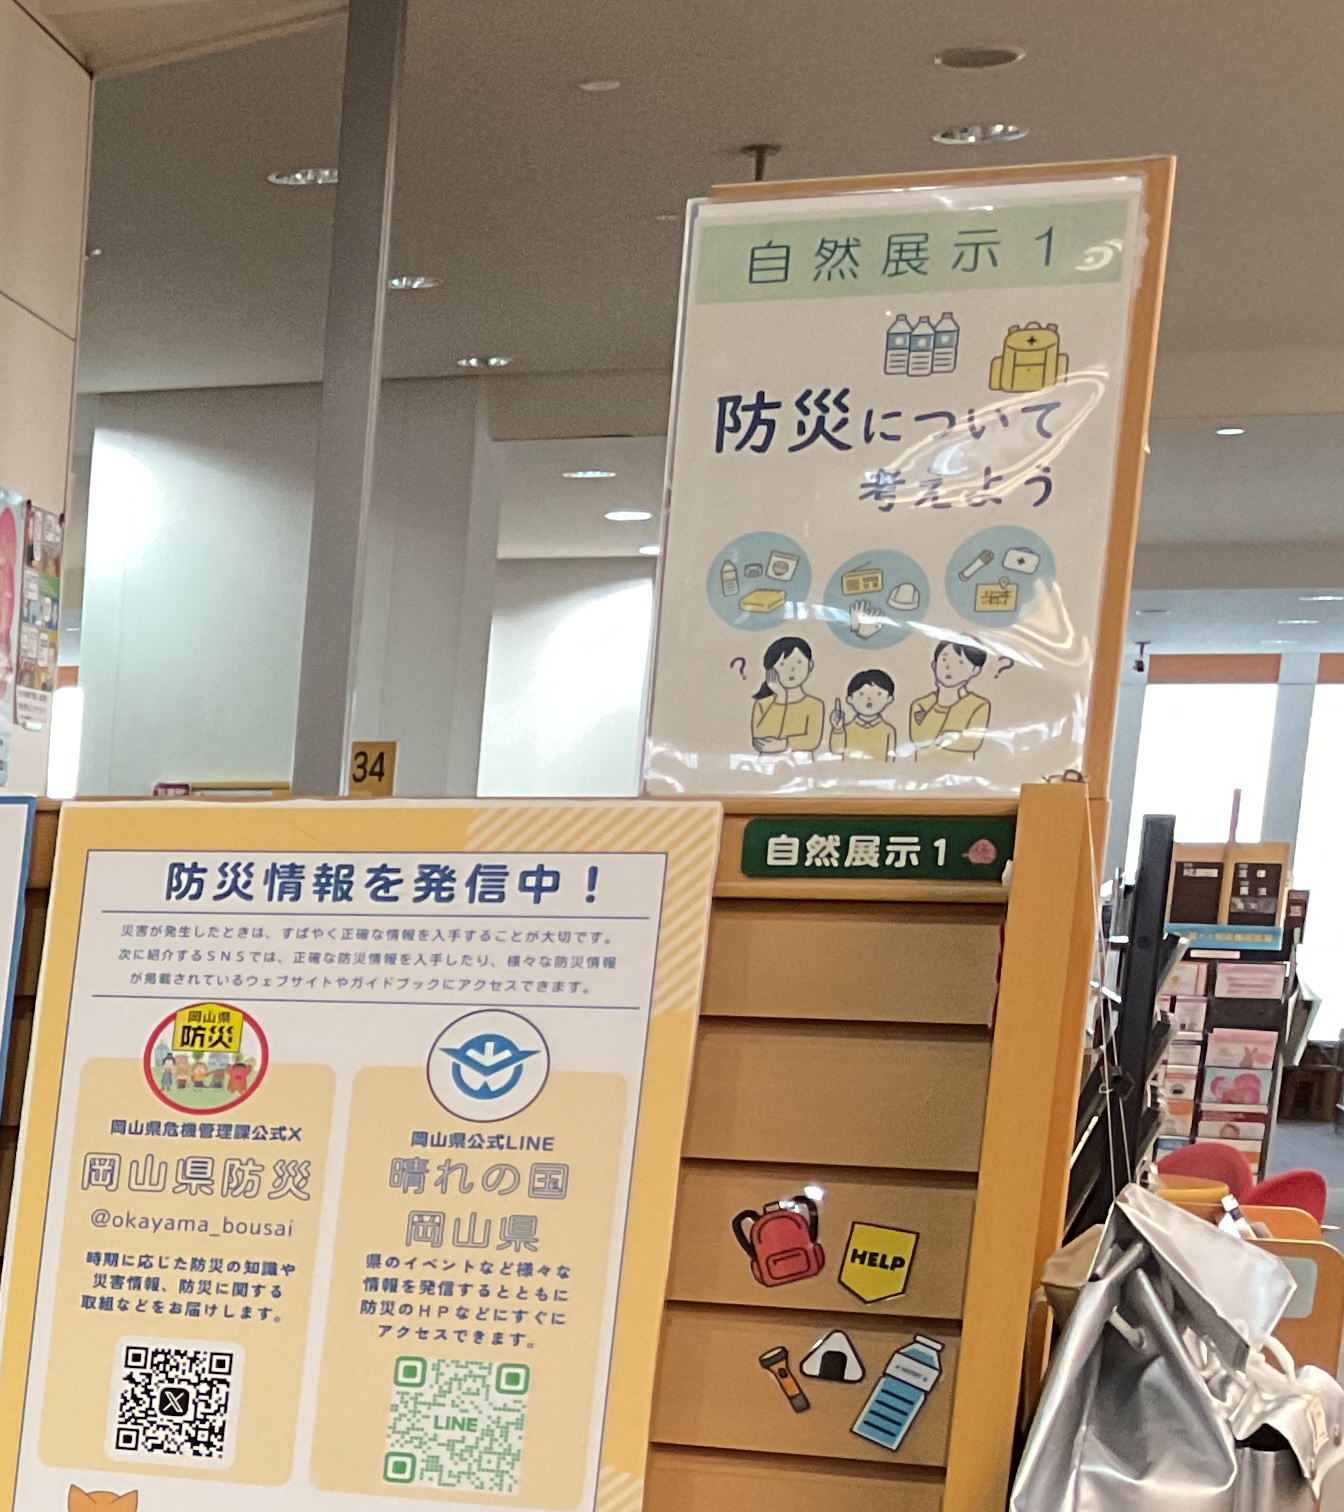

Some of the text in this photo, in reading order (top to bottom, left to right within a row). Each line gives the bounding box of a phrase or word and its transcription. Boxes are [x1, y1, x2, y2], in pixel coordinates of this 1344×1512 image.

[714, 386, 1063, 454] 防災について
[858, 465, 1054, 512] 考えよう
[351, 751, 386, 783] 34
[165, 860, 602, 905] 防災情報を発信中！
[120, 923, 612, 946] 災害が発生したときは、すばやく正確な情報を入手することが大切です。
[187, 1010, 231, 1024] 岡山県
[180, 1024, 234, 1050] 防災
[109, 1119, 303, 1143] 岡山県危機管理課公式X
[411, 1130, 555, 1153] 岡山県公式LINE
[80, 1151, 312, 1203] 岡山県防災
[388, 1157, 571, 1201] 晴れの国
[89, 1206, 295, 1239] @okayama_bousai
[404, 1210, 541, 1252] 岡山県
[85, 1251, 297, 1278] 時期に応じた防災の知識や
[365, 1253, 572, 1280] 県のイベントなど様々な
[849, 1246, 906, 1272] HELP
[92, 1273, 284, 1300] 災害情報、防災に関する
[362, 1275, 569, 1303] 情報を発信するとともに
[80, 1293, 283, 1324] 取組などをお届けします。
[358, 1299, 568, 1327] 防災のHPなどにすぐに
[376, 1323, 536, 1350] アクセスできます。
[432, 1413, 479, 1435] LINE
